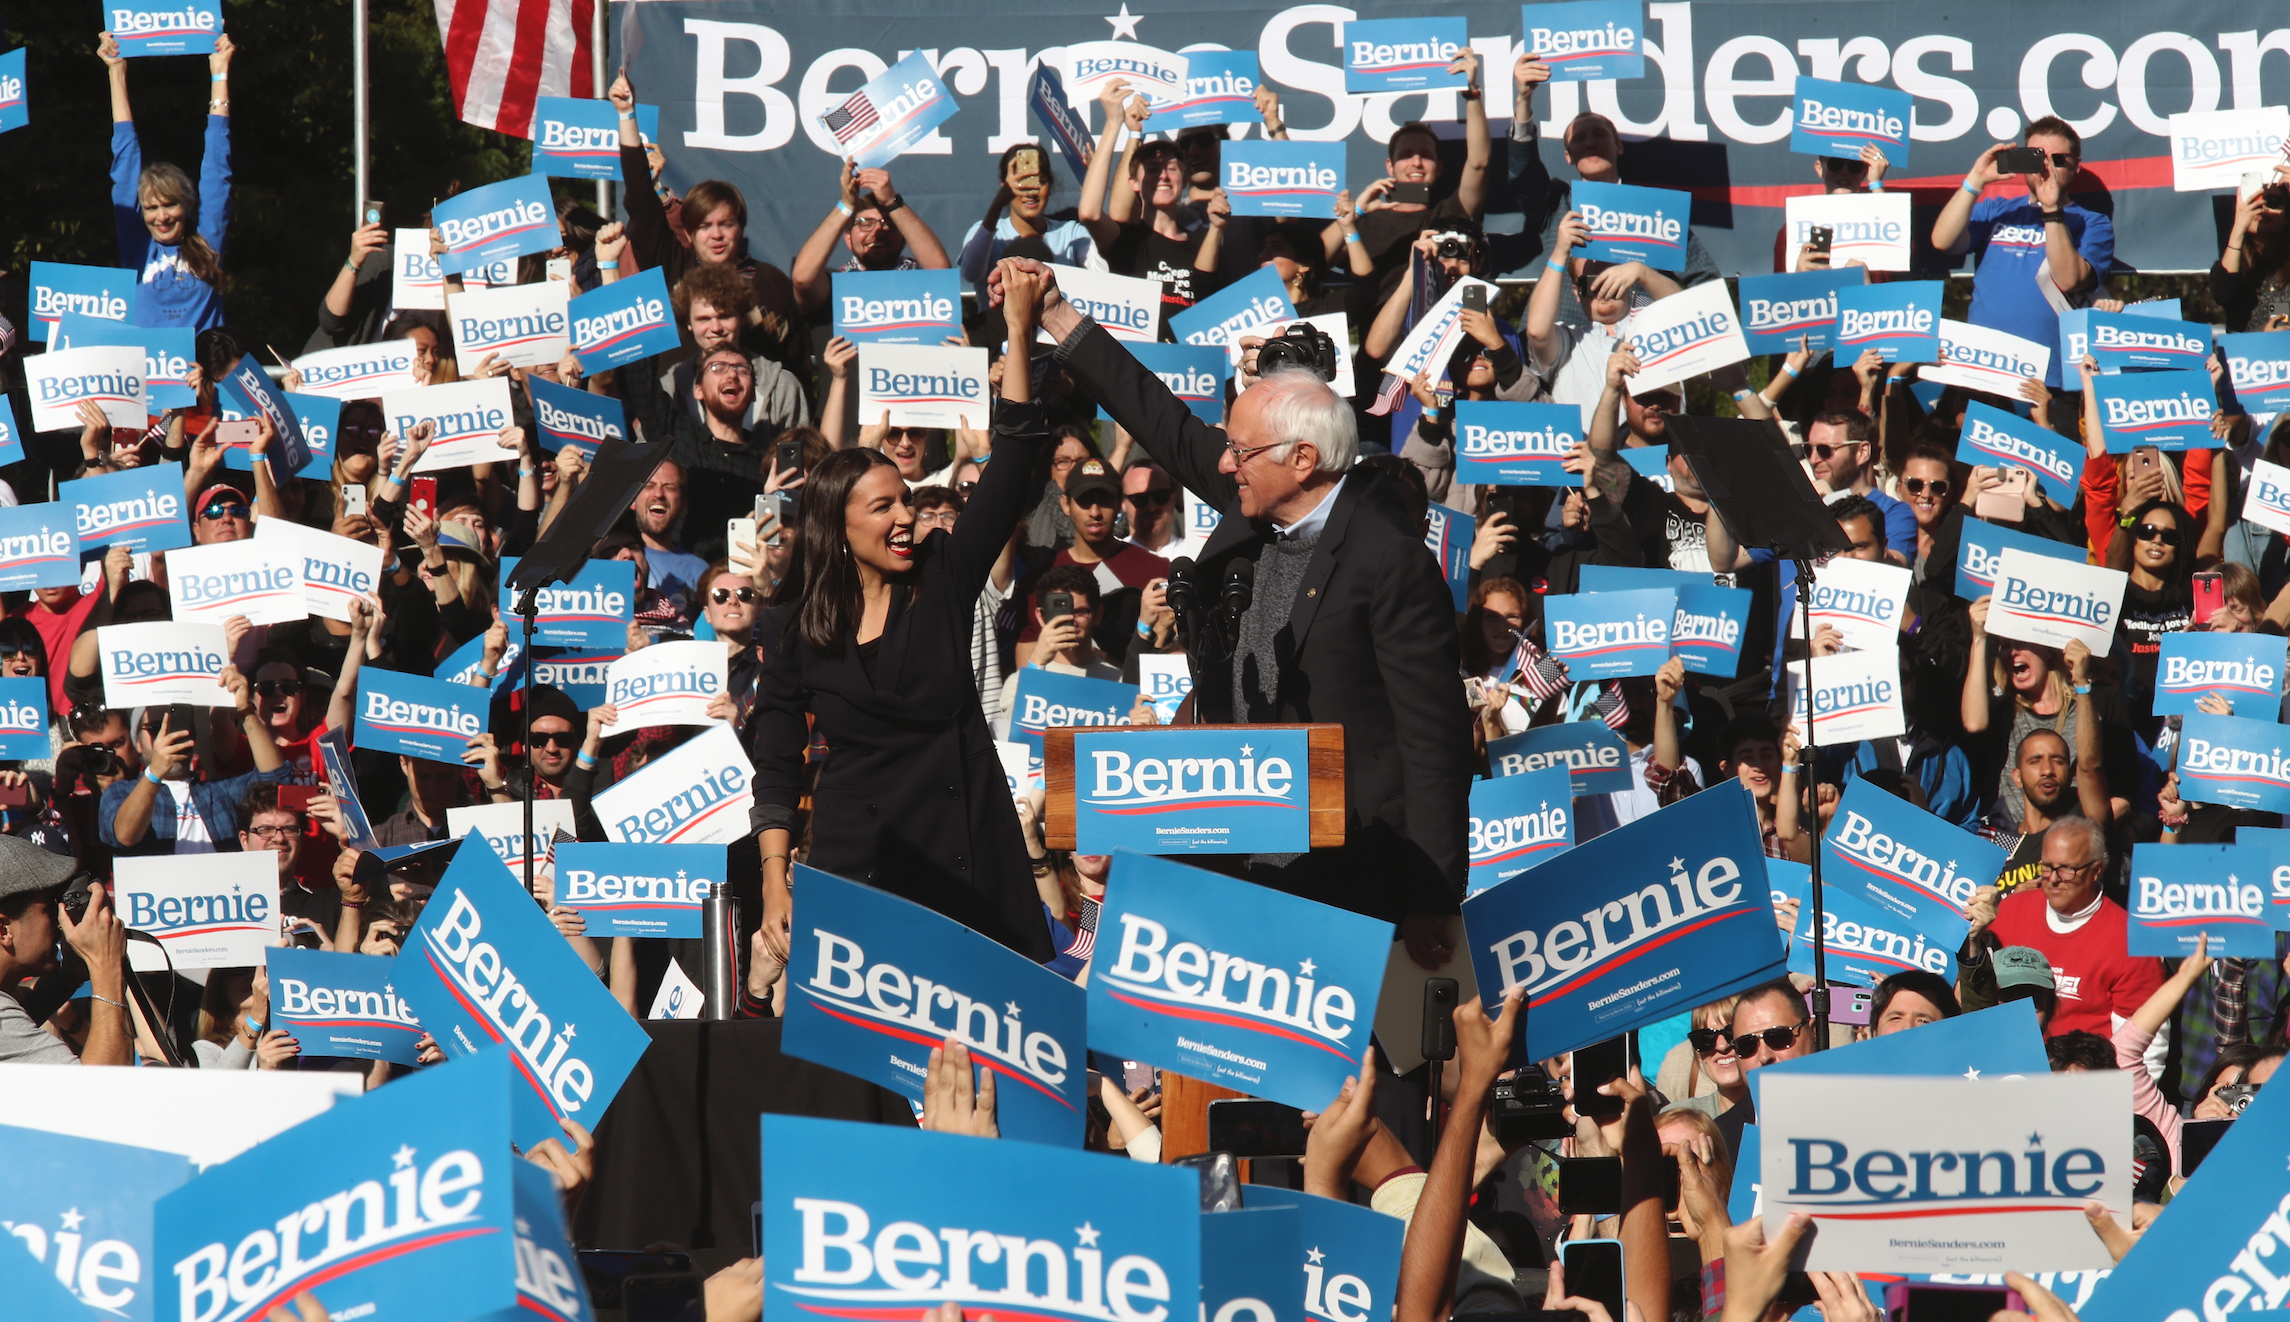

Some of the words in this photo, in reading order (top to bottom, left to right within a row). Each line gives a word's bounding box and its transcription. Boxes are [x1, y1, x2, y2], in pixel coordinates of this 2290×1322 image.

[112, 6, 214, 32] Bernie
[1532, 21, 1633, 54] Bernie
[1076, 54, 1177, 84] Bernie
[1352, 36, 1459, 66] Bernie
[542, 121, 648, 147] Bern
[1800, 99, 1903, 139] Bernie
[2181, 131, 2282, 163] Bernie
[1229, 161, 1336, 189] Bernie
[440, 199, 547, 246] Bernie
[1580, 204, 1681, 241] Bernie
[34, 287, 127, 321] Bernie
[574, 296, 665, 346] Bernie
[842, 292, 953, 323] Bernie
[1063, 299, 1149, 331] ernie
[1186, 296, 1286, 346] Bernie
[1747, 289, 1837, 328] Berni
[1841, 303, 1933, 337] Bernie
[460, 307, 564, 343] Bernie
[1404, 302, 1462, 373] Berni
[1632, 311, 1730, 360] Bernie
[2095, 325, 2204, 355] Bernie
[146, 349, 187, 379] nie
[302, 353, 410, 385] Bernie
[1939, 338, 2037, 379] Bernie
[38, 369, 140, 402] Bernie
[870, 368, 980, 398] Bernie
[236, 367, 300, 471] Bernie
[536, 398, 622, 439] Bernie
[2105, 391, 2211, 424] Bernie
[1465, 425, 1573, 454] Bernie
[1969, 419, 2073, 484] Bernie
[77, 491, 177, 534] Bernie
[0, 526, 70, 559] rnie
[179, 562, 293, 602] Bernie
[302, 557, 370, 593] rnie
[2001, 577, 2111, 626] Bernie
[1555, 613, 1667, 649] Bernie
[1672, 610, 1739, 645] Bernie
[111, 646, 222, 676] Bernie
[2164, 656, 2274, 689] Bernie
[613, 665, 718, 703] Bernie
[1797, 675, 1892, 715] Bernie
[366, 691, 479, 736] Bernie
[1091, 743, 1293, 798] Bernie
[1500, 742, 1620, 776] Bernie
[616, 768, 745, 845] Bernie
[1469, 800, 1566, 855] Bernie
[1835, 810, 1977, 905] Bernie
[566, 869, 713, 902] Bernie
[2138, 874, 2263, 917] Bernie
[127, 884, 268, 928] Bernie
[1490, 855, 1743, 1003] Bernie
[1805, 909, 1948, 974] Bernie
[1110, 912, 1357, 1041] Bernie
[1588, 968, 1680, 1011] BernieSanders.com
[431, 888, 594, 1113] Bernie
[809, 927, 1068, 1086] Bernie
[1177, 1036, 1266, 1070] BernieSanders.com
[1787, 1130, 2106, 1198] Bernie
[174, 1144, 484, 1322] Bernie
[1889, 1238, 2005, 1249] BernieSanders.com
[794, 1198, 1171, 1322] Bernie
